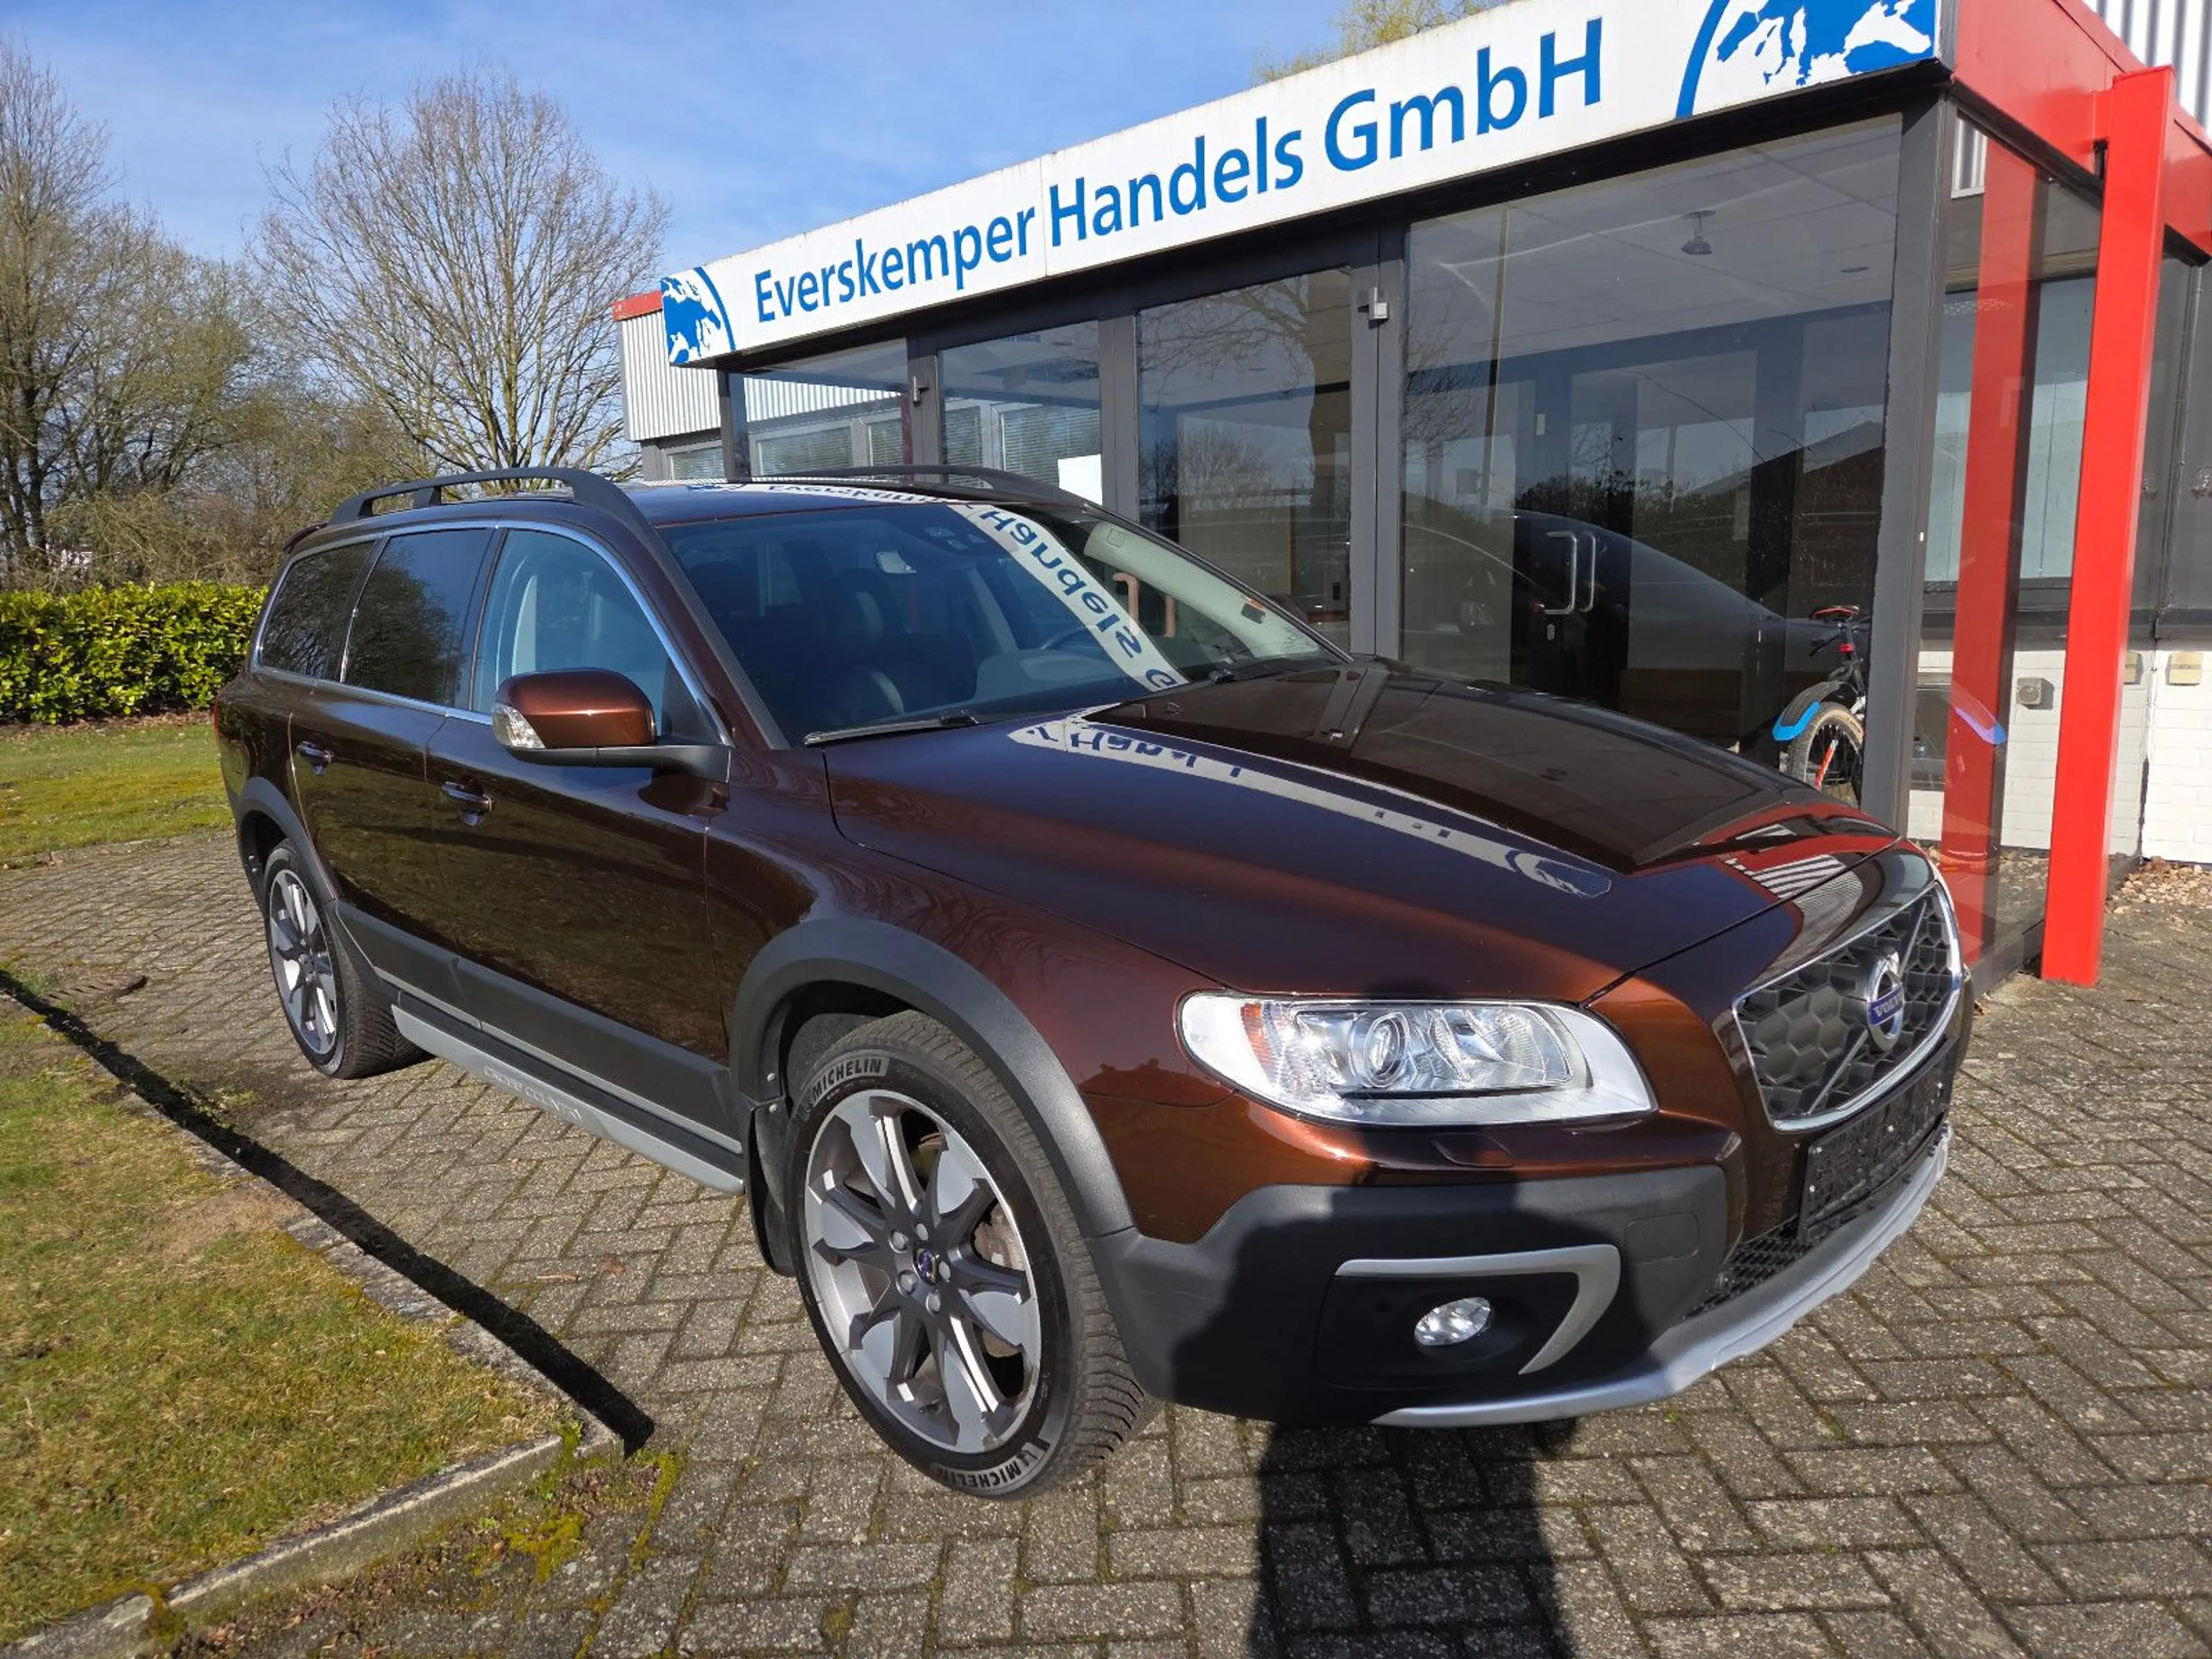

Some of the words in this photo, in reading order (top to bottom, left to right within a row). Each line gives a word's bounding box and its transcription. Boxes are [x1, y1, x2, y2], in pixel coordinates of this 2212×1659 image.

[755, 207, 1035, 322] Everskemper
[1050, 117, 1303, 247] Handels
[1325, 18, 1601, 171] GmbH
[813, 1058, 882, 1101] MICHELIN
[935, 1460, 1022, 1488] MICHELIN
